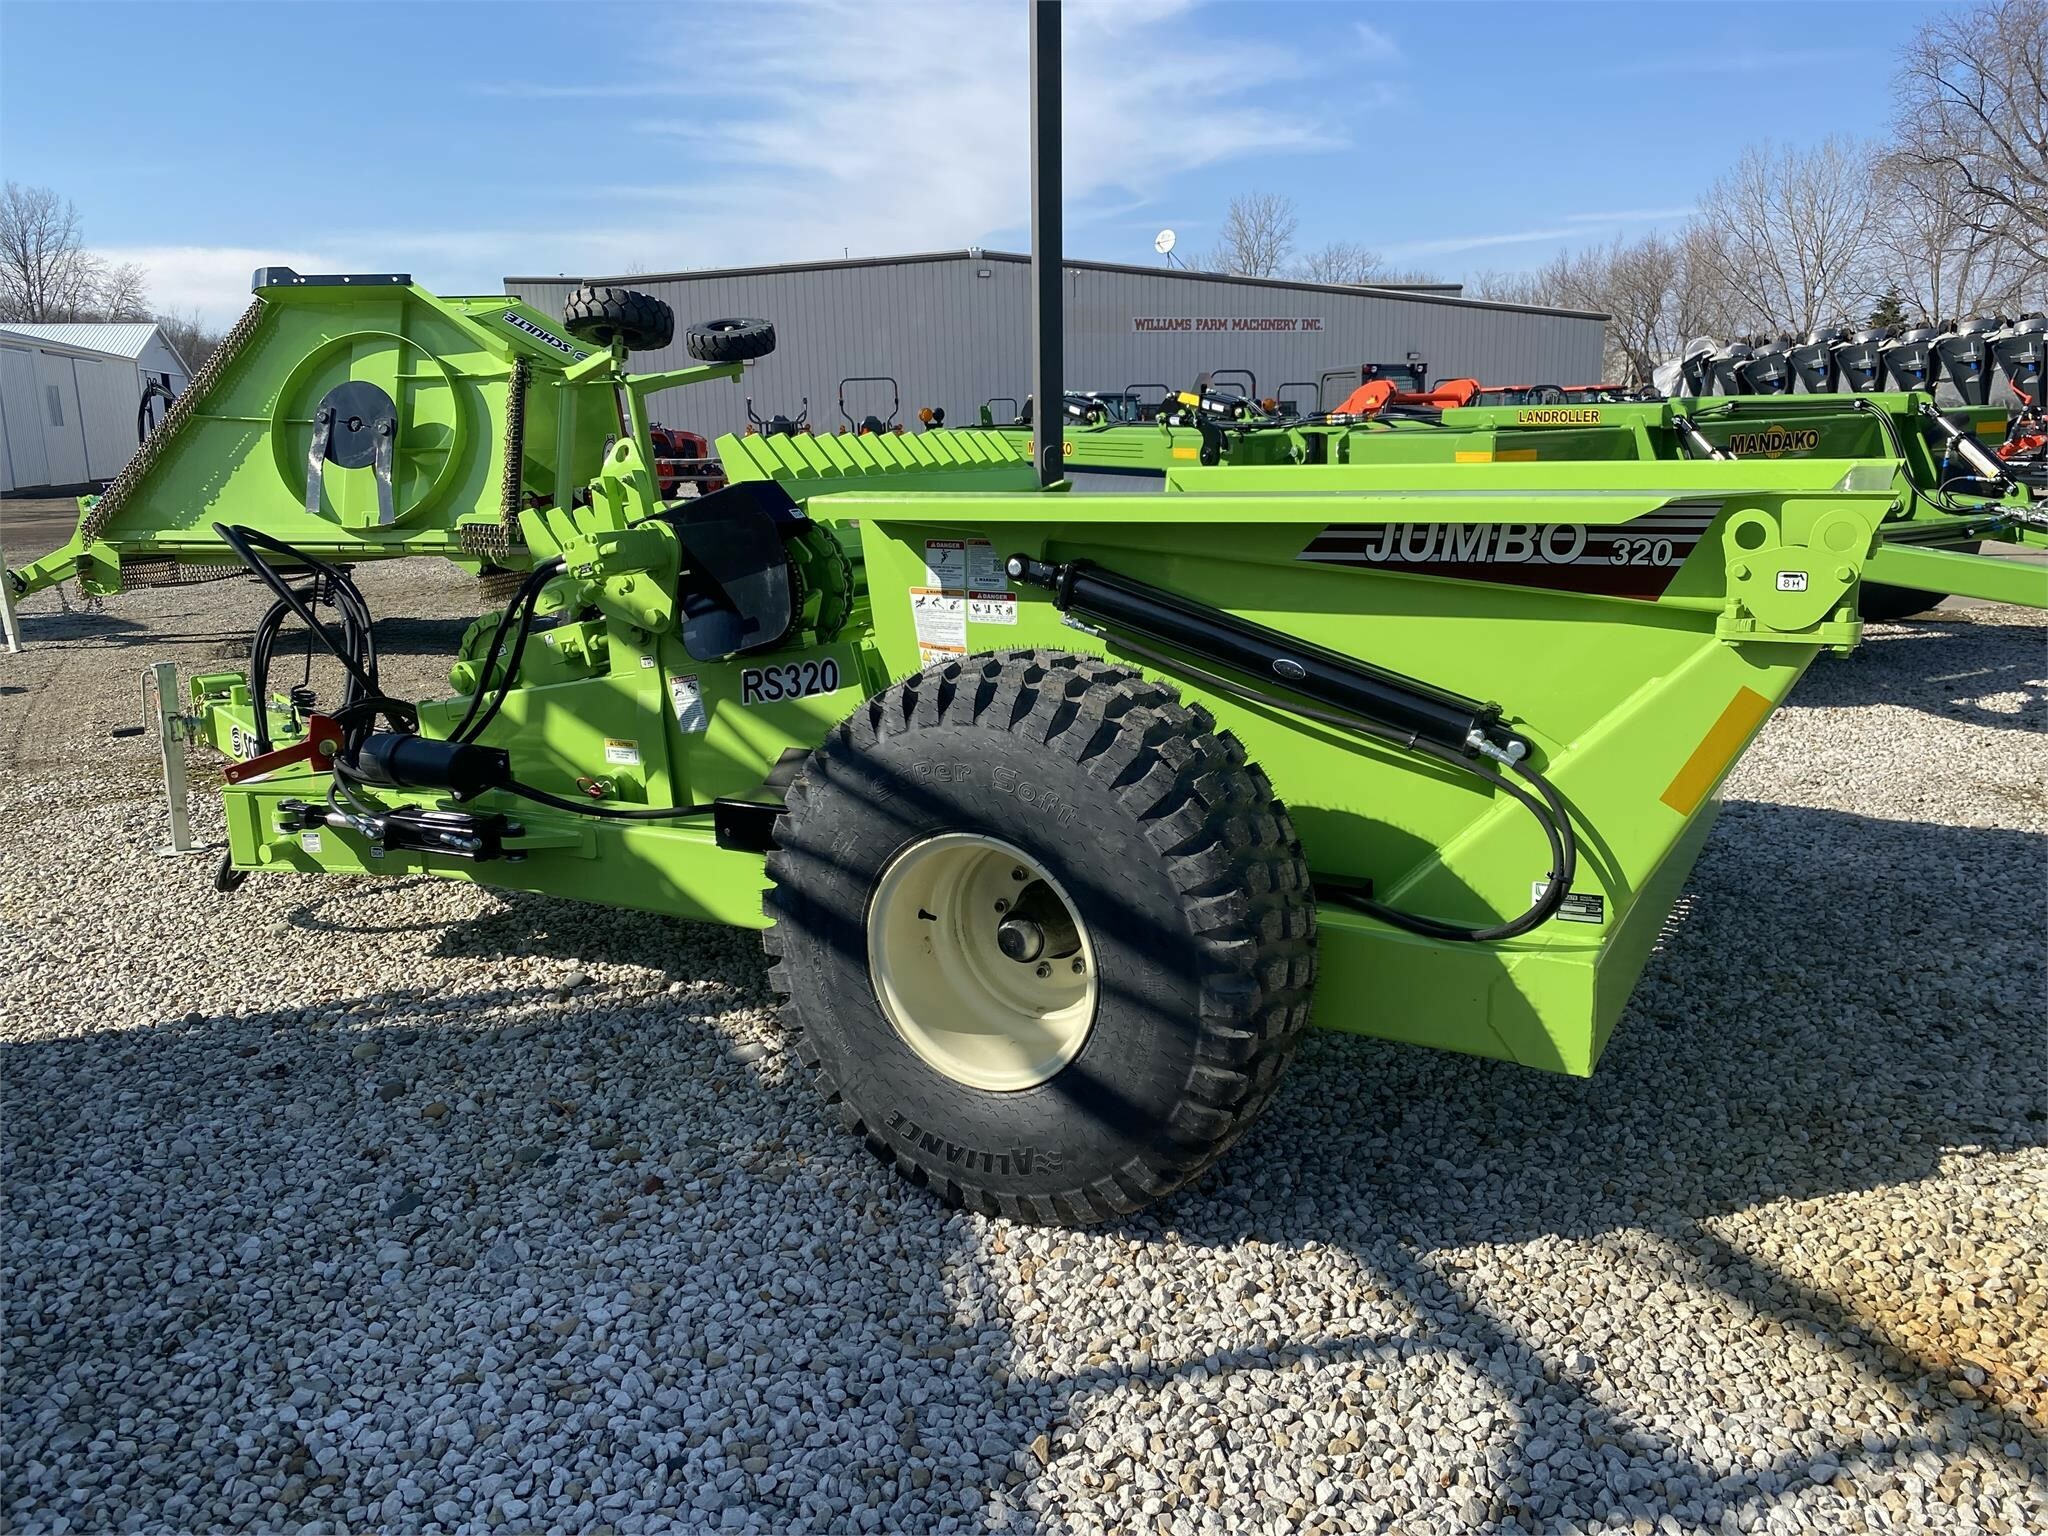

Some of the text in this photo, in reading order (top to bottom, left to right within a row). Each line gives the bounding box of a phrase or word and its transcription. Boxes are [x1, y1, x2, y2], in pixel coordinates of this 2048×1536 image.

[503, 311, 574, 353] SCHULTE
[1134, 318, 1192, 331] WILLIAMS
[1231, 318, 1298, 331] MACHINERY
[1301, 318, 1324, 331] INC.
[1518, 409, 1600, 424] LANDROLLER
[1730, 430, 1820, 454] MANDAKO
[1365, 523, 1673, 567] JUMBO 320
[741, 657, 839, 705] RS320
[884, 1109, 1034, 1176] ALLIANCE
